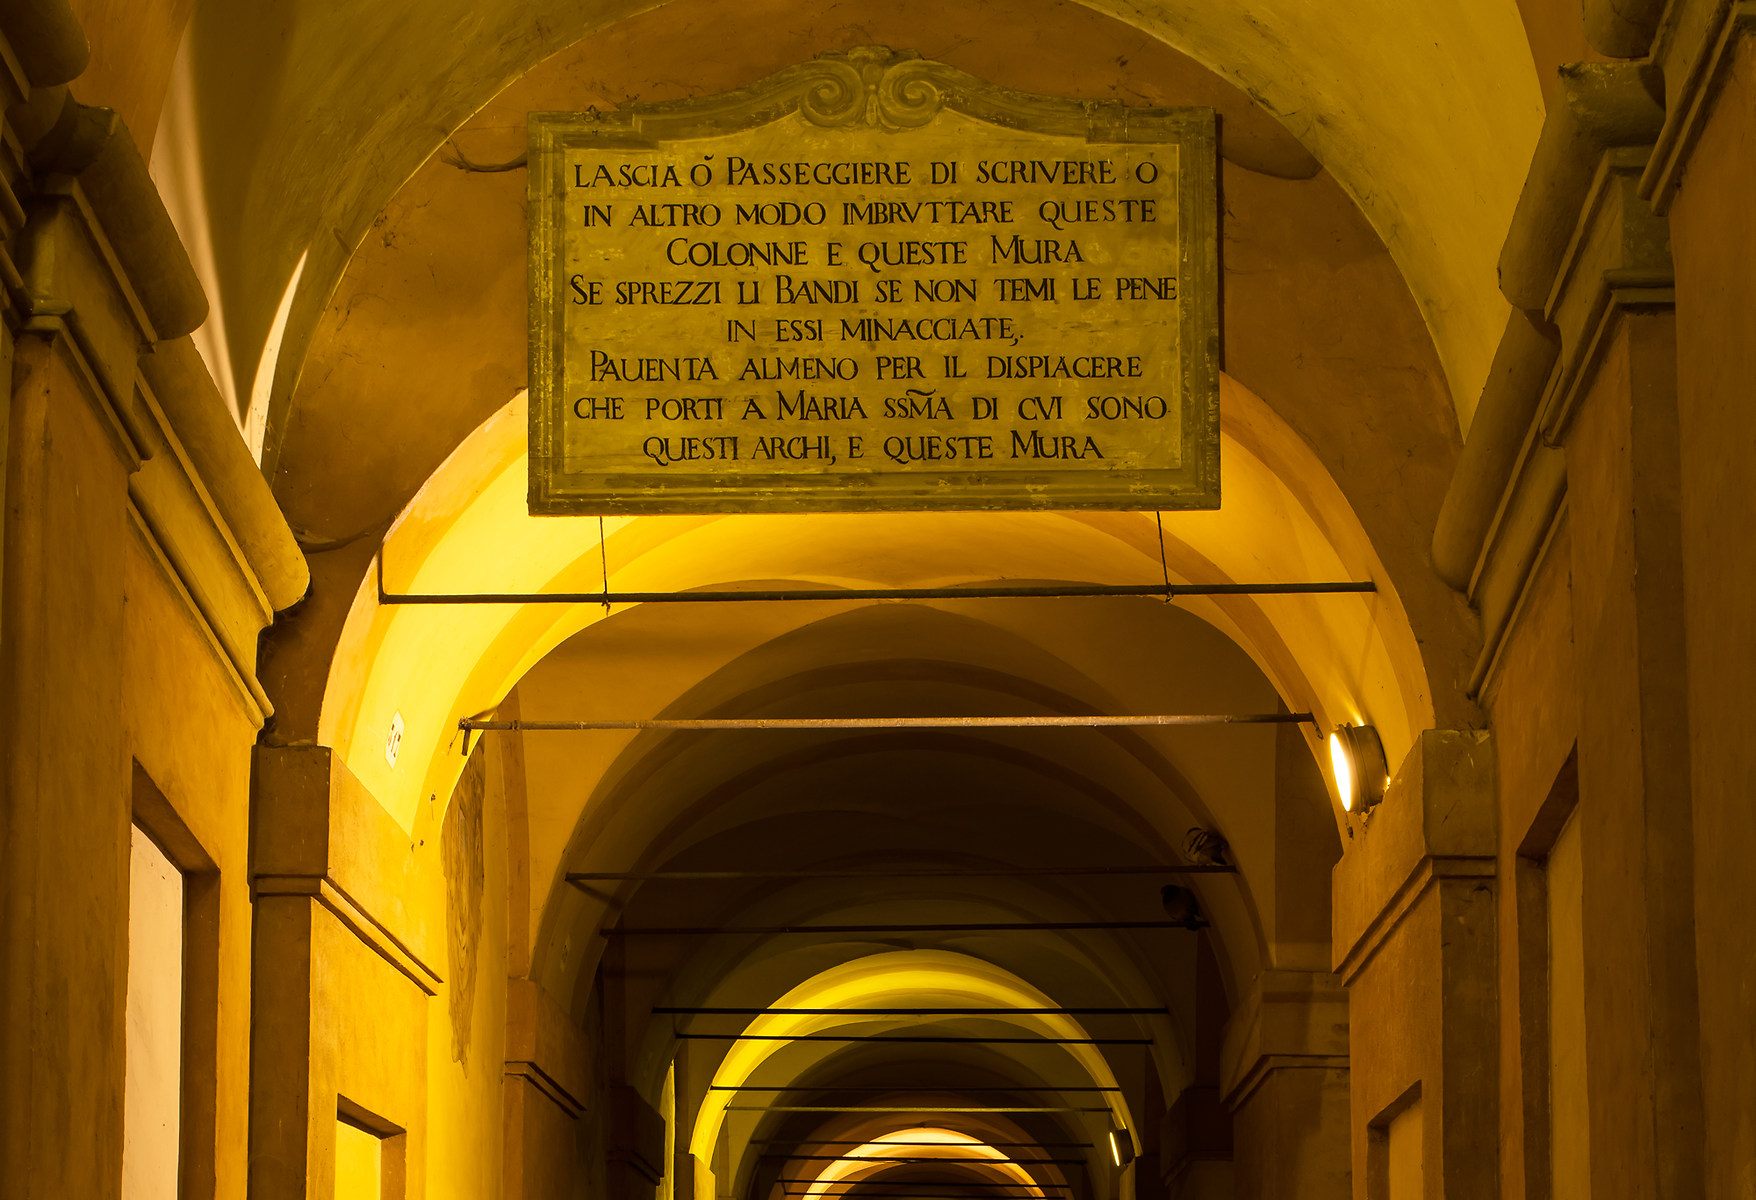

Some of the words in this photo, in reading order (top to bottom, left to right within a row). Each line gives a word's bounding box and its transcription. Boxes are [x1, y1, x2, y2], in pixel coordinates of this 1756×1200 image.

[574, 164, 682, 188] LASCIA
[727, 156, 911, 186] PASSEGGIERE
[931, 162, 956, 184] DI
[976, 160, 1116, 184] SCRIVERE
[1136, 162, 1158, 184] O
[584, 205, 612, 227] IN
[629, 204, 721, 227] ALTRO
[736, 202, 826, 225] MODO
[1039, 199, 1156, 230] QUESTE
[667, 238, 808, 266] COLONNE
[827, 242, 842, 265] E
[859, 241, 968, 273] QUESTE
[991, 235, 1084, 264] MURA
[570, 275, 603, 305] SE
[616, 281, 721, 305] SPREZZI
[776, 275, 858, 304] BANDI
[875, 279, 902, 303] SE
[915, 279, 977, 302] NON
[994, 278, 1055, 302] TEMI
[1073, 278, 1101, 301] LE
[1116, 277, 1177, 301] PENE
[728, 320, 755, 342] IN
[776, 319, 823, 342] ESSI
[739, 357, 859, 380] ALMENO
[877, 356, 926, 380] PER
[945, 356, 967, 378] IL
[987, 355, 1143, 379] DISPIACERE
[573, 397, 624, 420] CHE
[645, 397, 723, 420] PORTI
[742, 398, 767, 420] A
[777, 389, 868, 420] MARIA
[972, 397, 998, 420] DI
[1086, 396, 1168, 420] SONO
[643, 436, 739, 466] QUESTI
[752, 435, 837, 466] ARCHI,
[848, 436, 864, 458] E
[883, 435, 993, 464] QUESTE
[1011, 430, 1104, 459] MURA
